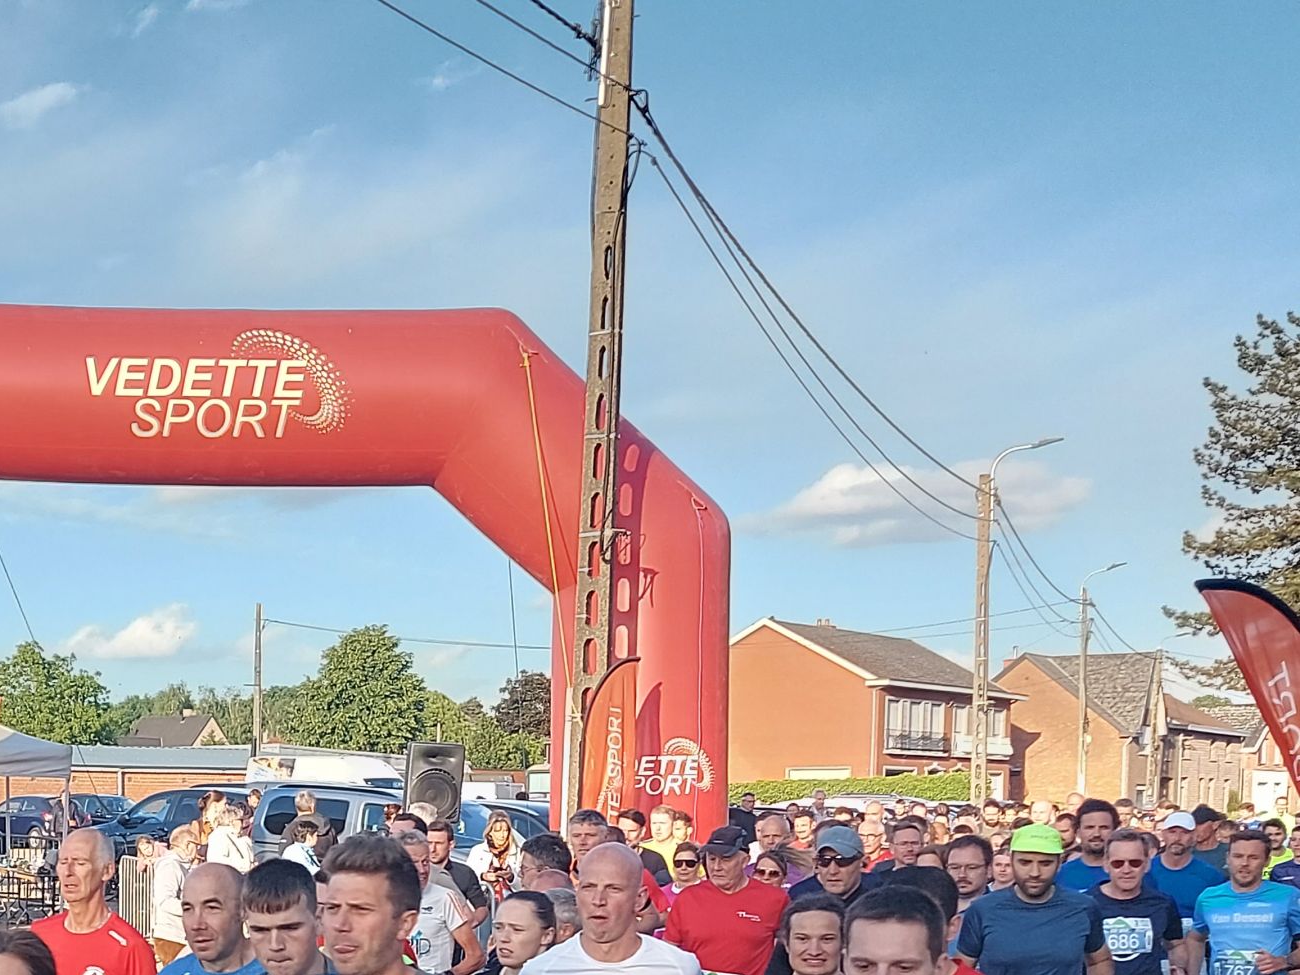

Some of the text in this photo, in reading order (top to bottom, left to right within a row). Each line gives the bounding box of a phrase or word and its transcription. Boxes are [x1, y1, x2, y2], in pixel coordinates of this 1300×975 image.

[85, 357, 307, 397] VEDETTE
[130, 398, 300, 438] SPORT
[635, 755, 699, 775] ETTE
[635, 774, 698, 796] PORT
[1108, 933, 1140, 949] 686
